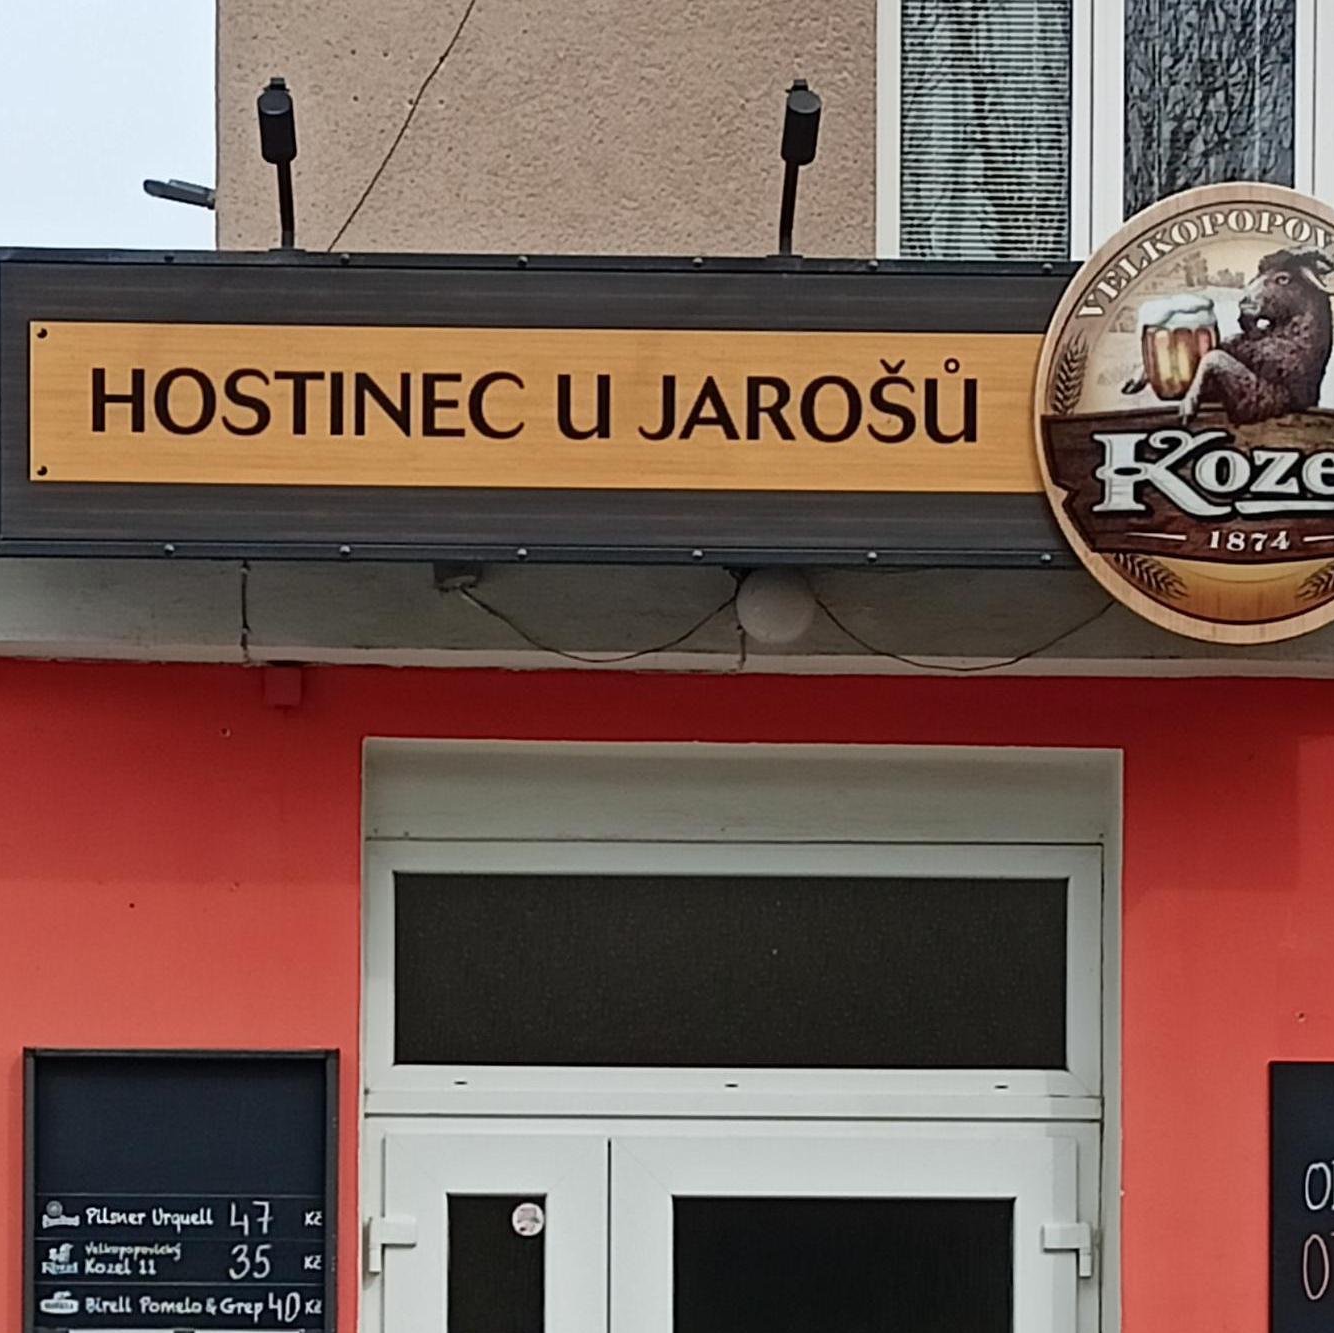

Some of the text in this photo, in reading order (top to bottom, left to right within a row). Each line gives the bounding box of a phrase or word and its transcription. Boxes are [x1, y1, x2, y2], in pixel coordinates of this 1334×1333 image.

[91, 357, 978, 444] HOSTINEC U JAROŠŮ
[1209, 530, 1291, 551] 1874
[85, 1206, 147, 1226] Pilsner
[152, 1207, 214, 1234] Urquell
[229, 1200, 274, 1237] 47
[304, 1210, 323, 1227] Kč
[84, 1257, 132, 1275] Kozel
[228, 1243, 272, 1281] 35
[84, 1296, 132, 1314] Birell
[139, 1295, 202, 1315] Pomelo
[219, 1297, 264, 1324] Grep
[268, 1291, 301, 1323] 40
